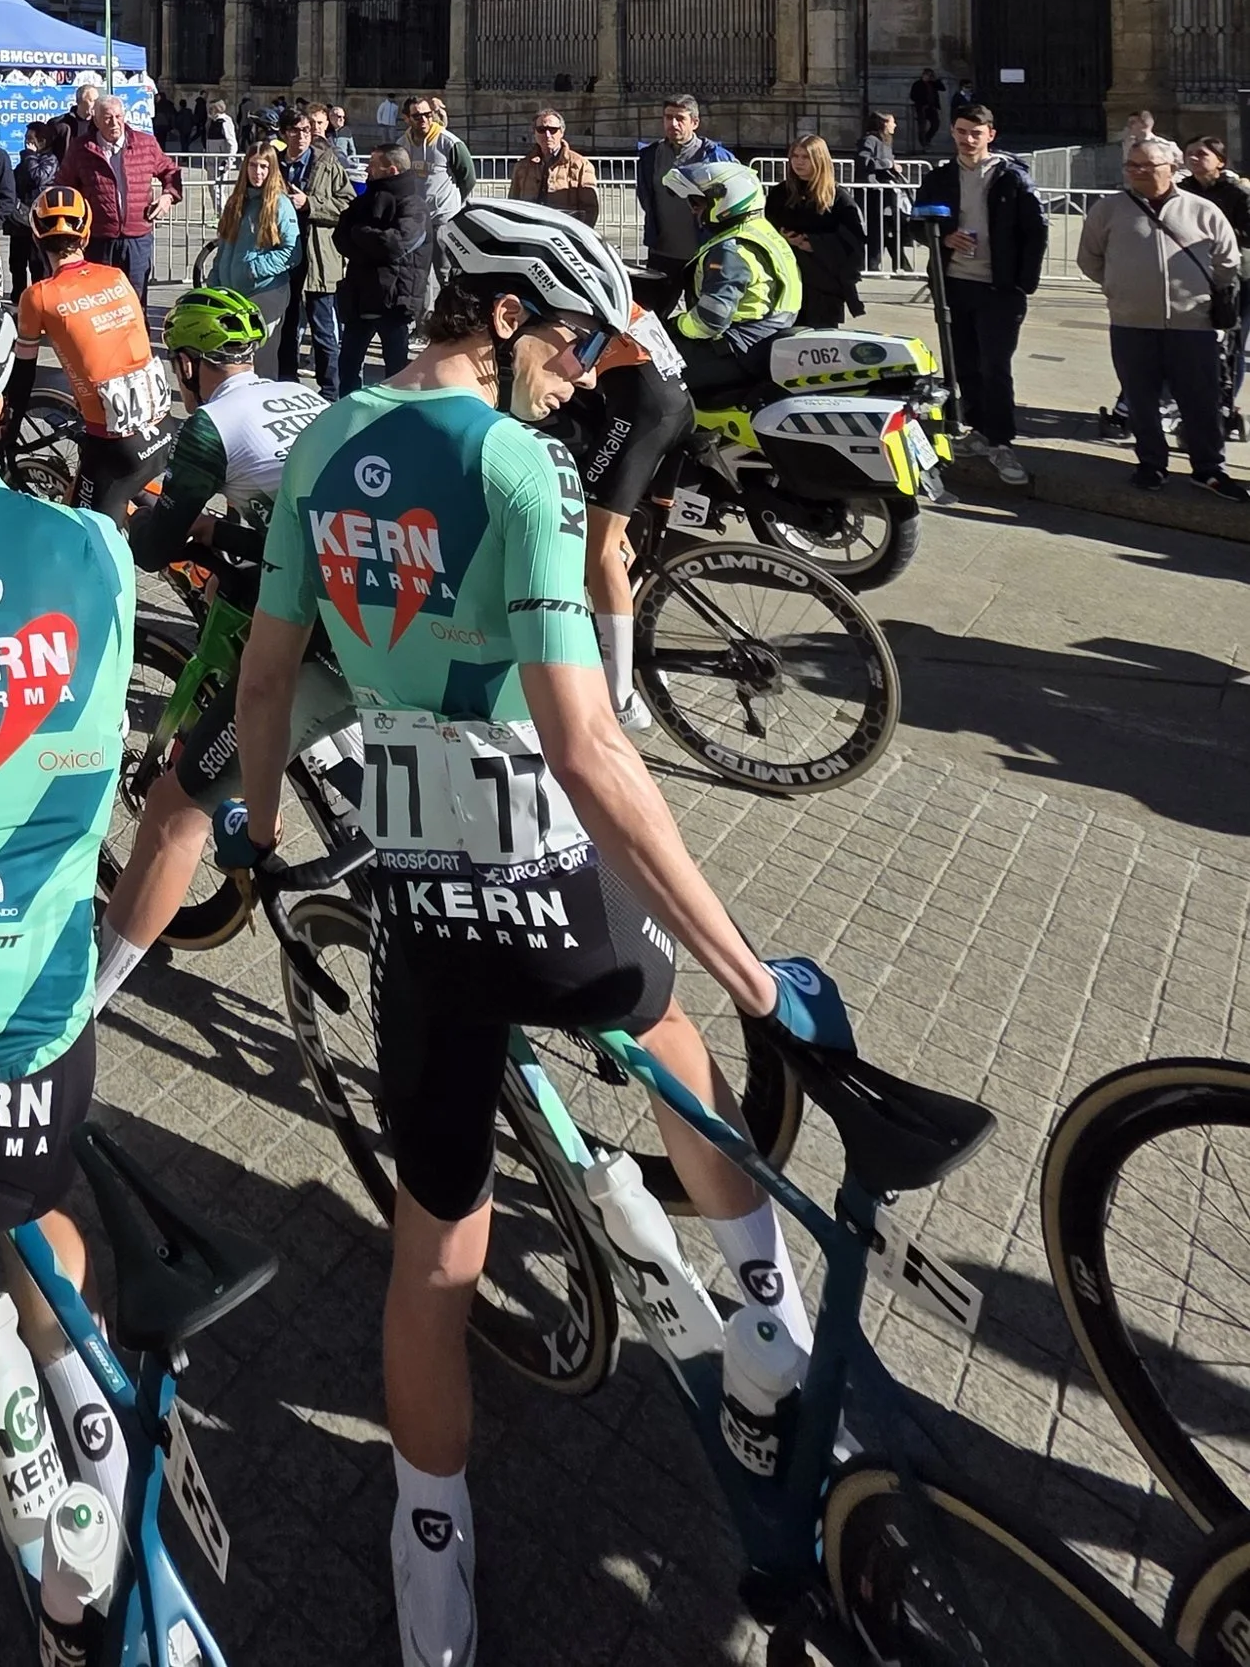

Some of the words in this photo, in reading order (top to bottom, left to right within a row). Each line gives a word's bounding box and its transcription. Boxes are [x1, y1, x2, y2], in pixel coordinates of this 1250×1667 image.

[20, 99, 58, 110] COMO
[531, 262, 557, 290] KERN
[550, 237, 596, 284] GIANT
[56, 276, 129, 318] euskaltel
[810, 347, 841, 365] 062
[111, 387, 143, 429] 94
[262, 392, 327, 414] CAJA
[587, 417, 632, 483] euskaltel
[682, 501, 705, 523] 91
[309, 509, 446, 574] KERN
[322, 564, 456, 601] PHARMA
[669, 560, 704, 585] NO
[704, 553, 809, 587] LIMITED
[430, 621, 487, 647] Oxicol
[38, 746, 105, 771] Oxicol
[704, 742, 810, 784] LIMITED
[812, 754, 849, 780] NO
[470, 752, 552, 854] 77
[380, 851, 460, 872] UROSPORT
[406, 880, 571, 927] KERN
[414, 920, 579, 950] PHARMA
[901, 1241, 971, 1326] 77
[648, 1296, 680, 1325] RN
[181, 1454, 224, 1570] 75
